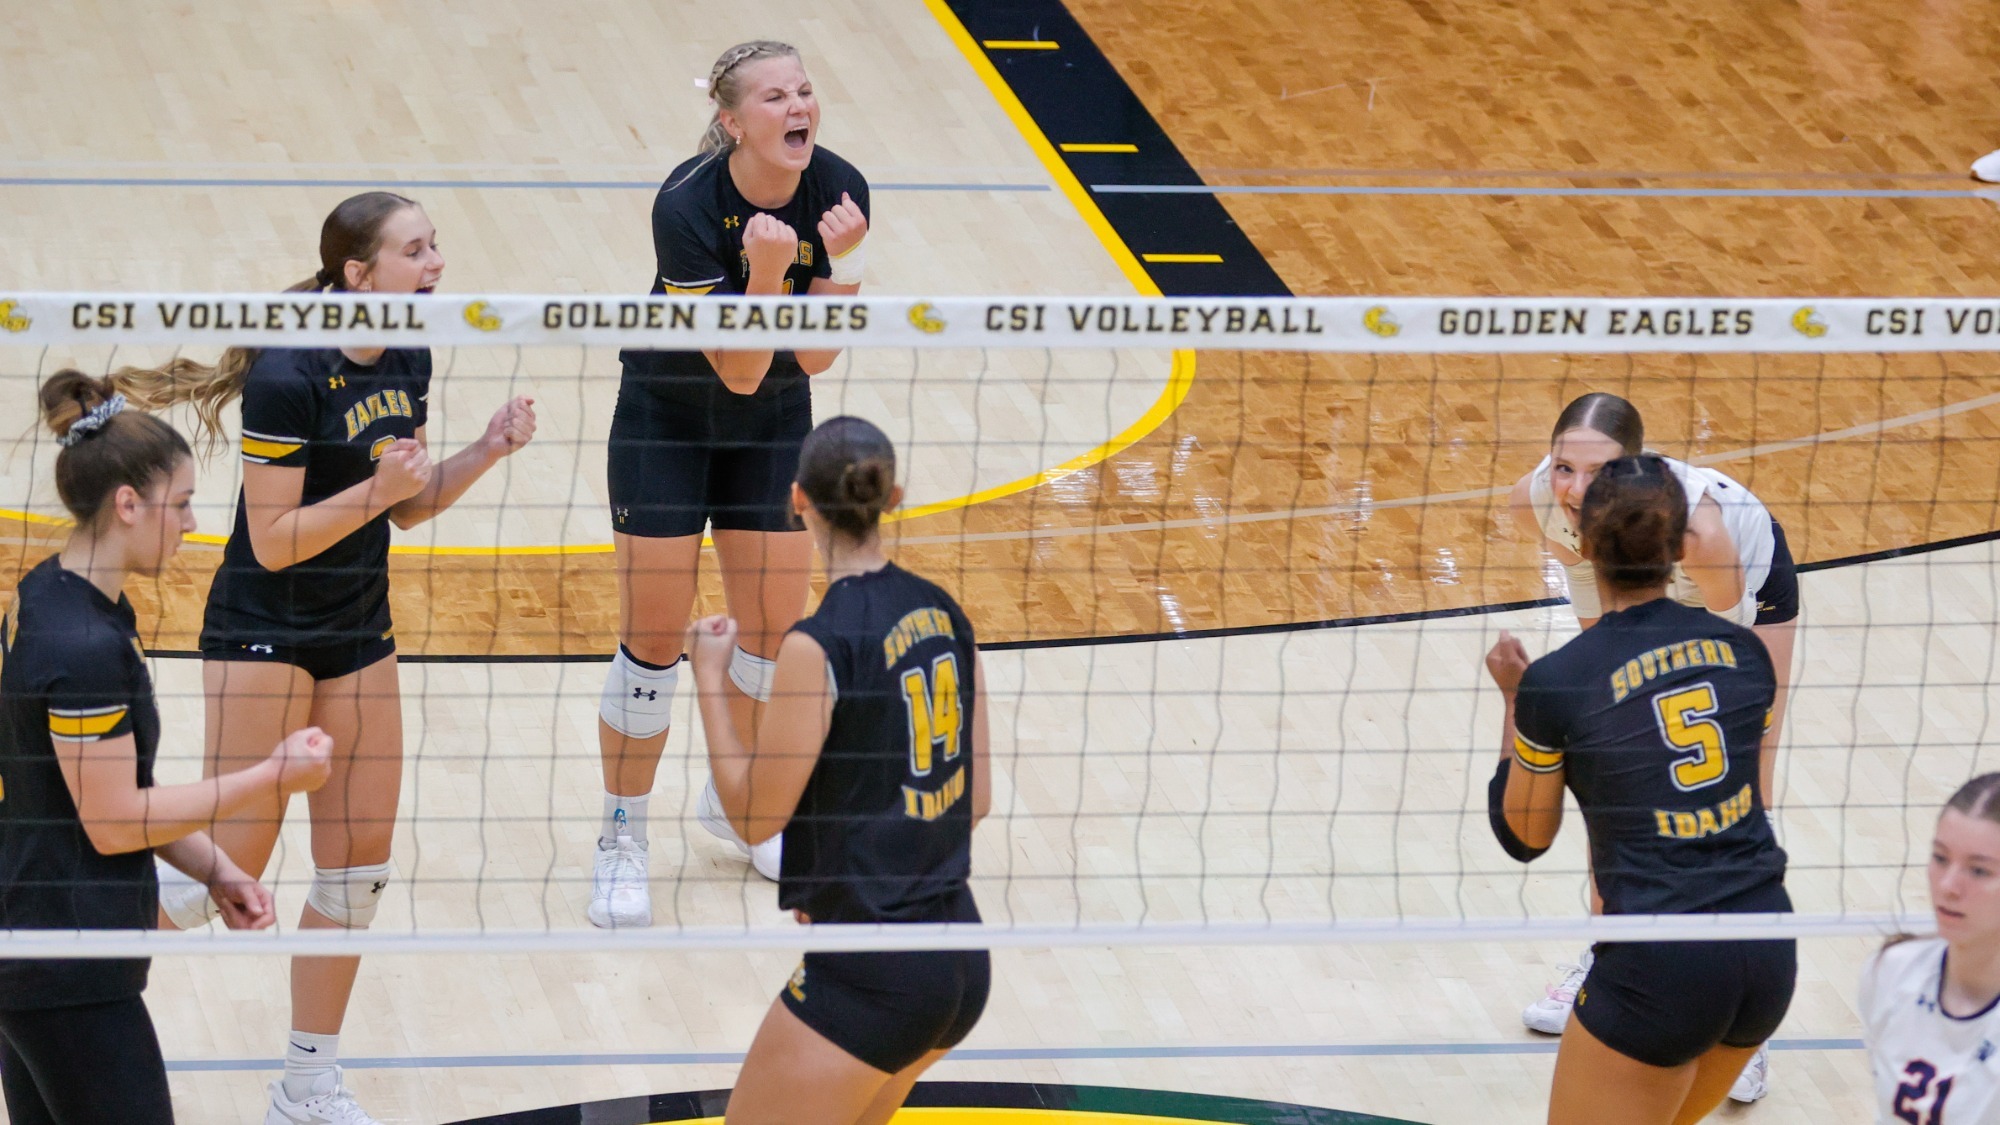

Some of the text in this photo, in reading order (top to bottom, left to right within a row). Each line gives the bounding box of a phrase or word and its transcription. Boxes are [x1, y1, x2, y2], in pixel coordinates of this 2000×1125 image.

[73, 302, 424, 331] CSI VOLLEYBALL
[543, 302, 868, 331] GOLDEN EAGLES
[985, 304, 1324, 334] CSI VOLLEYBALL
[1439, 308, 1753, 336] GOLDEN EAGLES
[1866, 308, 2000, 335] CSI VO
[1610, 638, 1738, 703] SOUTHERN
[900, 651, 963, 777] 14
[1652, 681, 1730, 792] 5
[1653, 783, 1753, 839] IDAHO
[1893, 1058, 1954, 1125] 21
